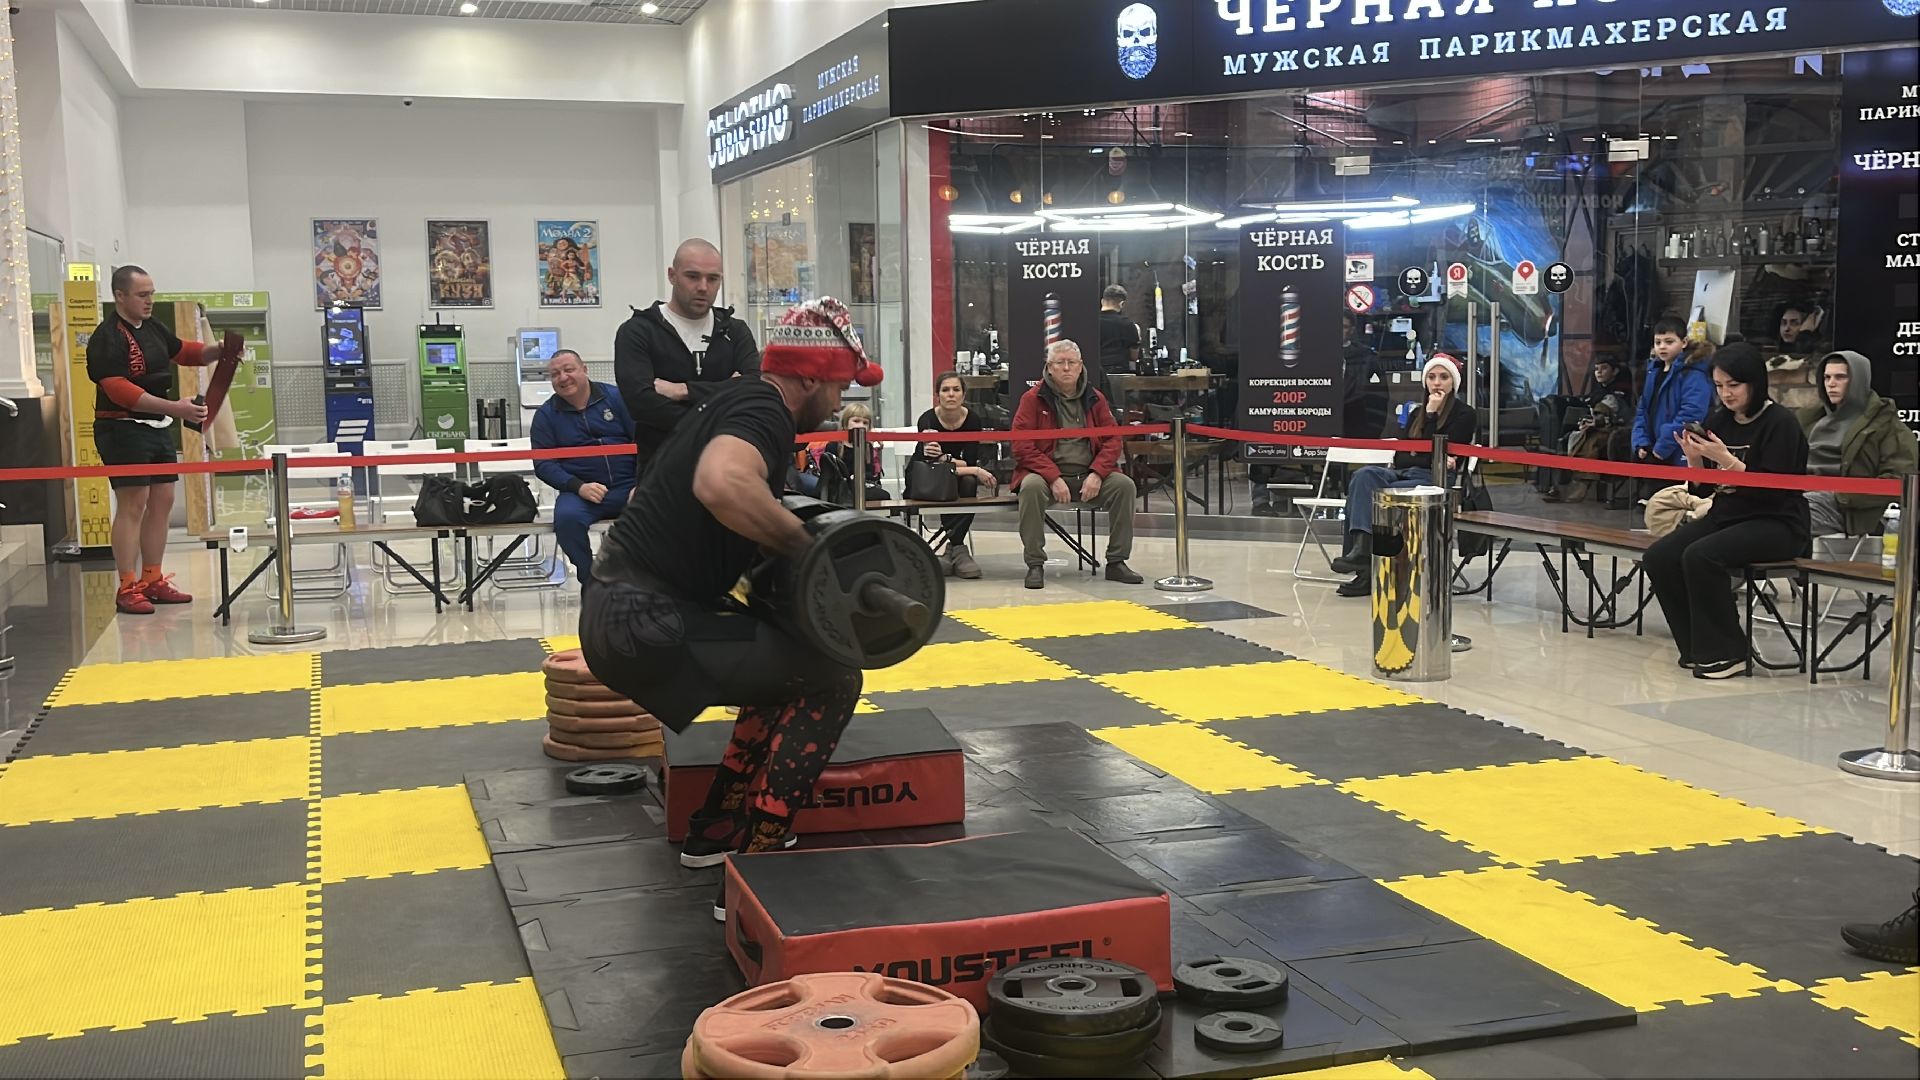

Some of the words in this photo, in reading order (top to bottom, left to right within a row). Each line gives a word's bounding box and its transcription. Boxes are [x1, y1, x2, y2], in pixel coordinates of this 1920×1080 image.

[1223, 42, 1390, 75] МУЖСКАЯ
[1419, 7, 1787, 60] ПАРИКМАХЕРСКАЯ
[817, 55, 858, 90] МУЖСКАЯ
[803, 74, 879, 123] ПАРИКМАХЕРСКАЯ
[583, 228, 592, 238] 2
[1249, 228, 1334, 247] ЧЁРНАЯ
[1016, 238, 1090, 256] ЧЁРНАЯ
[1257, 254, 1325, 271] КОСТЬ
[1022, 263, 1082, 279] КОСТЬ
[1273, 391, 1306, 403] 200Р
[1249, 407, 1296, 415] КАМУФЛЯЖ
[1298, 407, 1332, 416] БОРОДЫ
[1273, 420, 1306, 431] 500Р
[1257, 448, 1275, 456] Google
[1303, 448, 1316, 457] App
